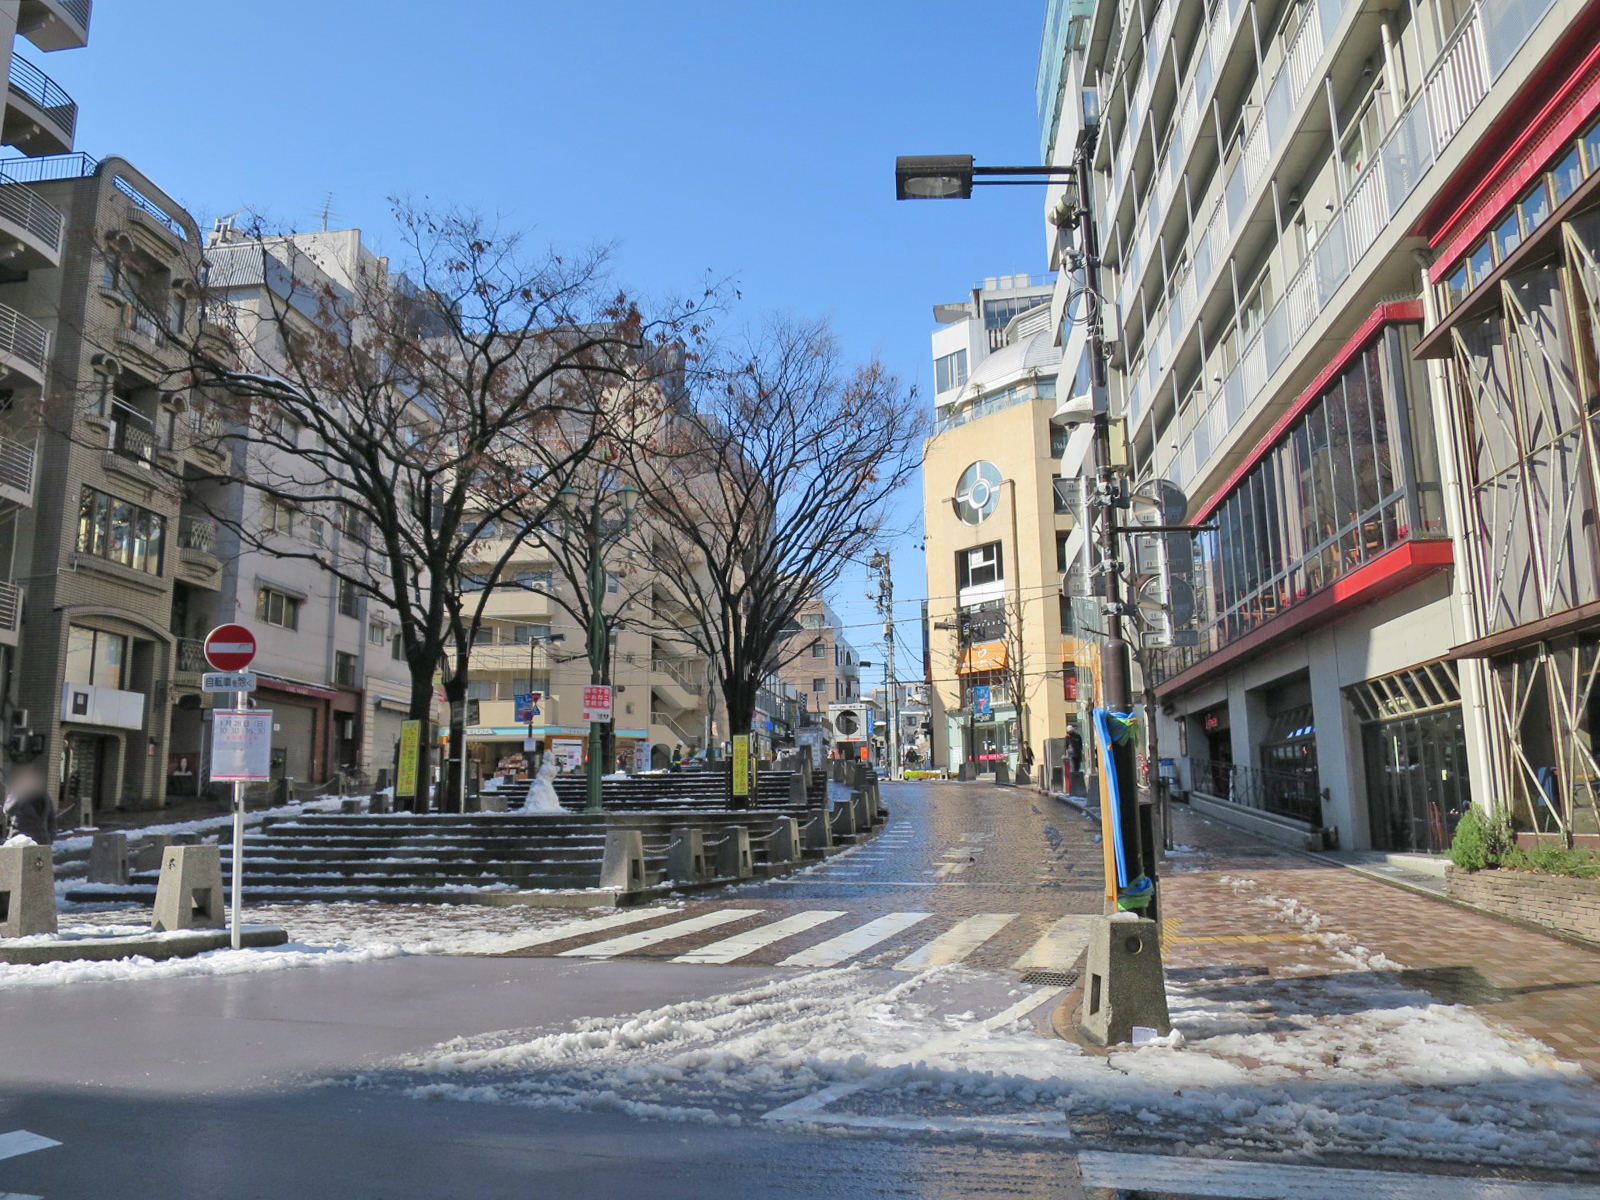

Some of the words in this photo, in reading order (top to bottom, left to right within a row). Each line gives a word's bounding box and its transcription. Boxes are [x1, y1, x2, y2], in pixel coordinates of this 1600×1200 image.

[206, 676, 252, 688] 自転車を除く
